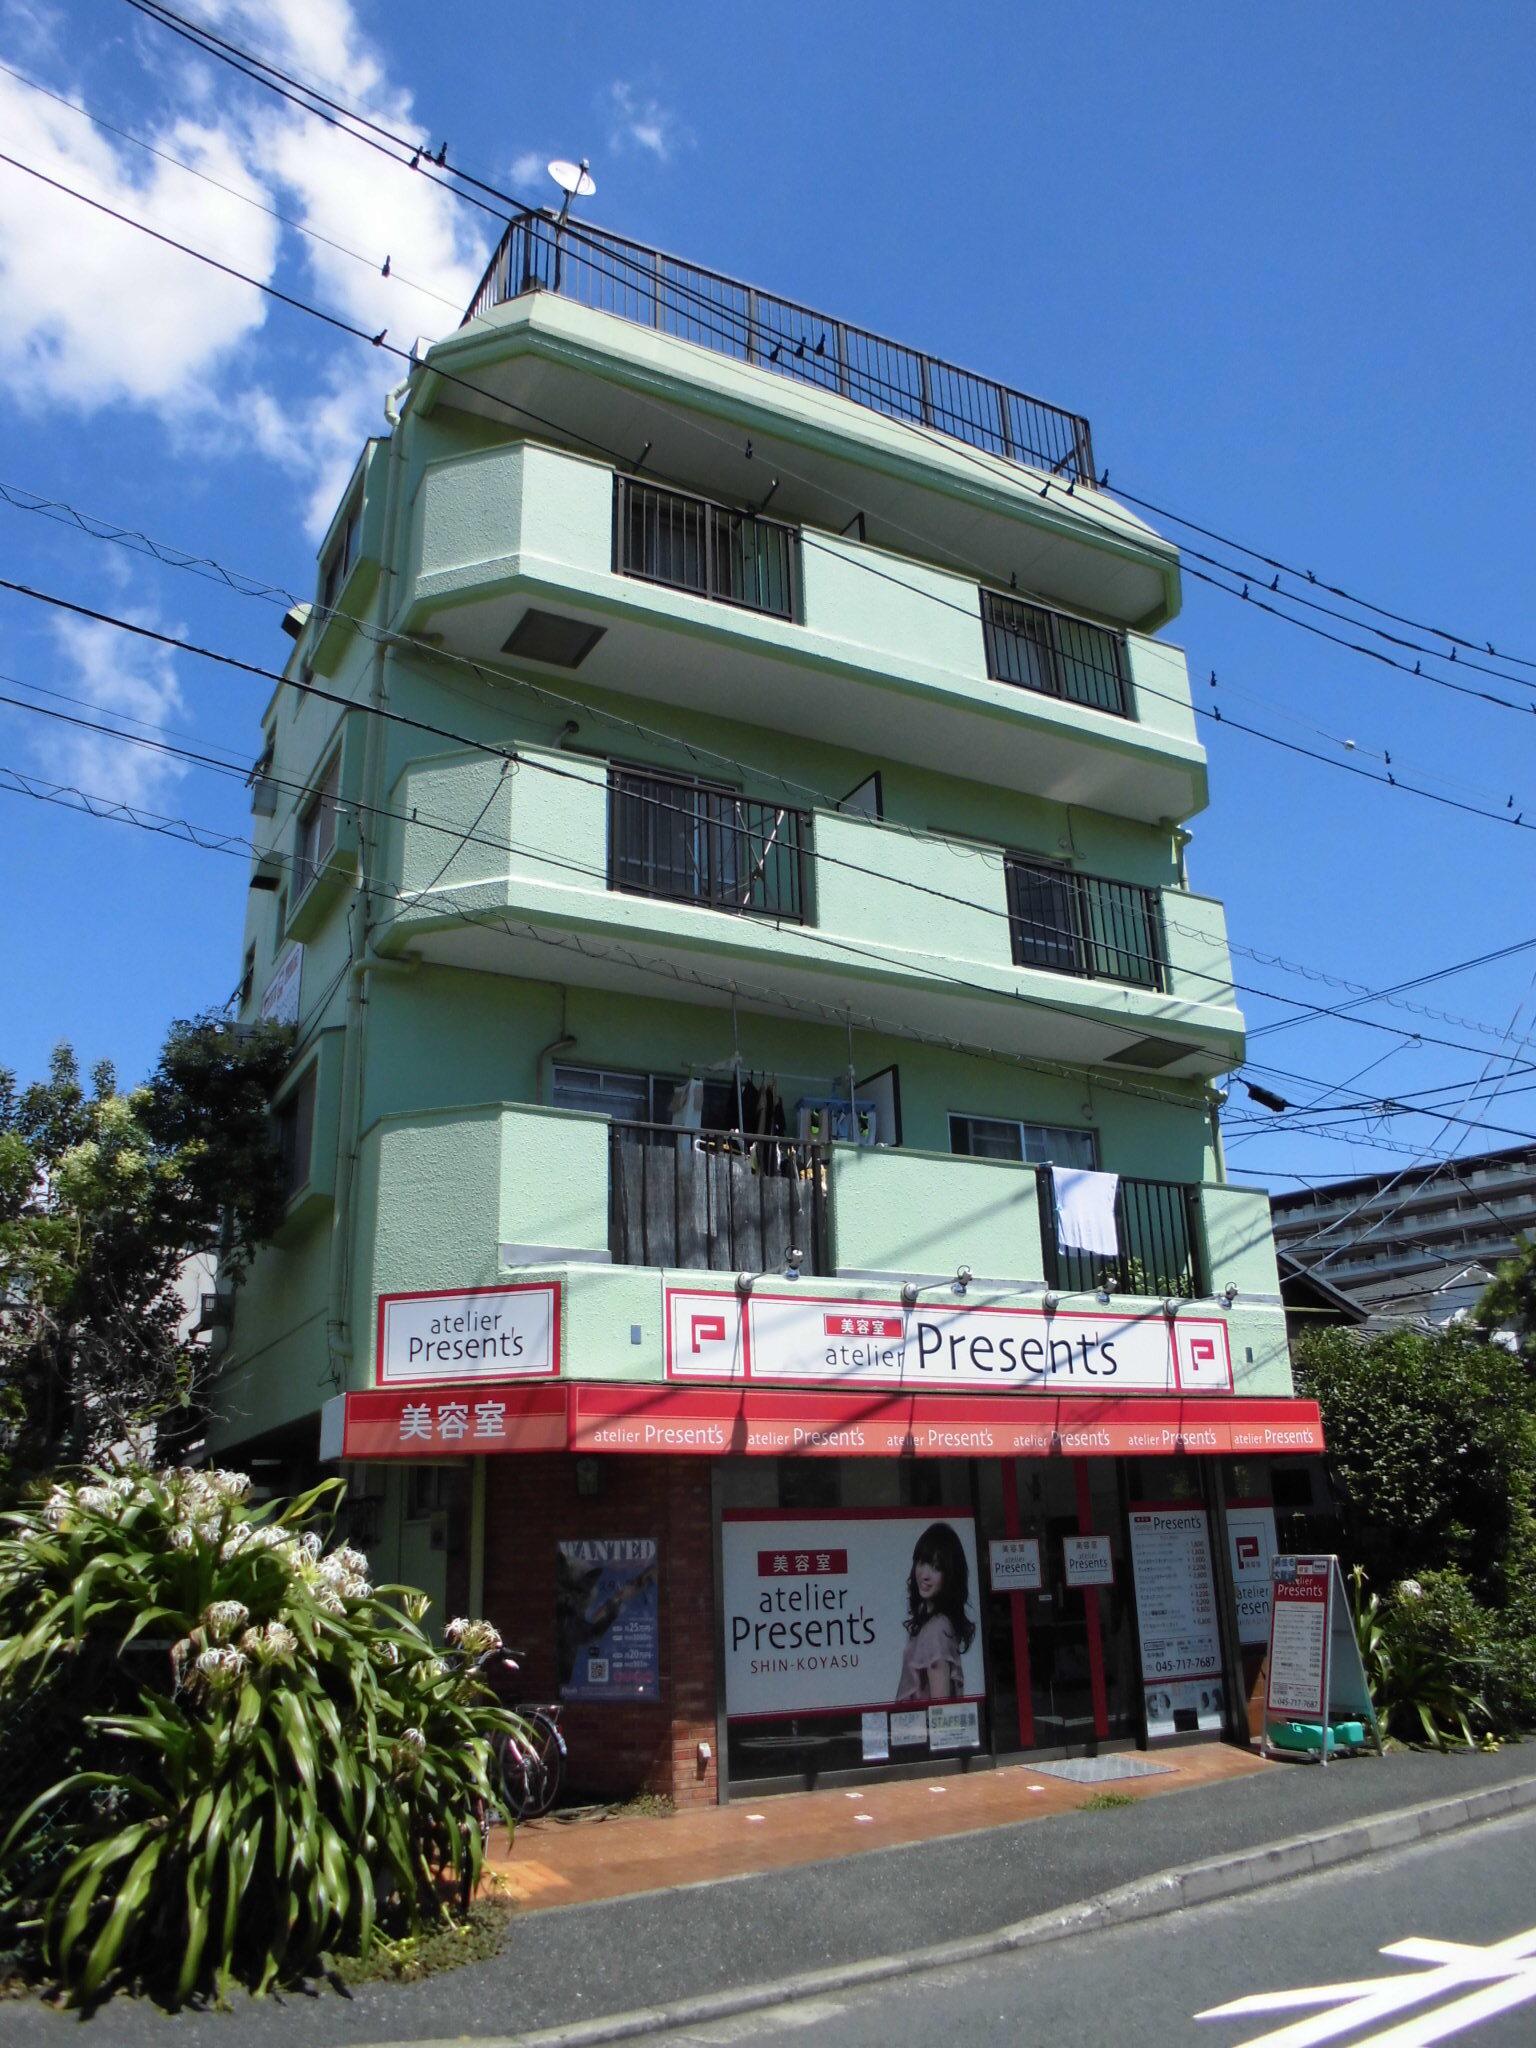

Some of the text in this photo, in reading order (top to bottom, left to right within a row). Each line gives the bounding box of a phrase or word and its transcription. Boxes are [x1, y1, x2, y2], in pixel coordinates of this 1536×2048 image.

[431, 1311, 502, 1334] atelier
[841, 1318, 886, 1335] 美容室
[409, 1327, 523, 1362] Present's
[917, 1322, 1117, 1375] Present's
[825, 1344, 905, 1367] atelier
[400, 1400, 506, 1440] 美容室
[594, 1424, 723, 1444] atelier Present's
[748, 1427, 865, 1446] atelier Present's
[887, 1428, 993, 1446] atelier Present's
[1014, 1429, 1110, 1447] atelier Present's
[1128, 1429, 1216, 1446] atelier Present's
[1234, 1428, 1313, 1445] atelier Present's
[559, 1540, 656, 1560] WANTED
[773, 1554, 831, 1572] 美容室
[760, 1583, 847, 1613] atelier
[733, 1606, 875, 1652] Present's
[750, 1654, 859, 1674] SHIN-KOYASU
[1156, 1656, 1215, 1672] 045-717-7687
